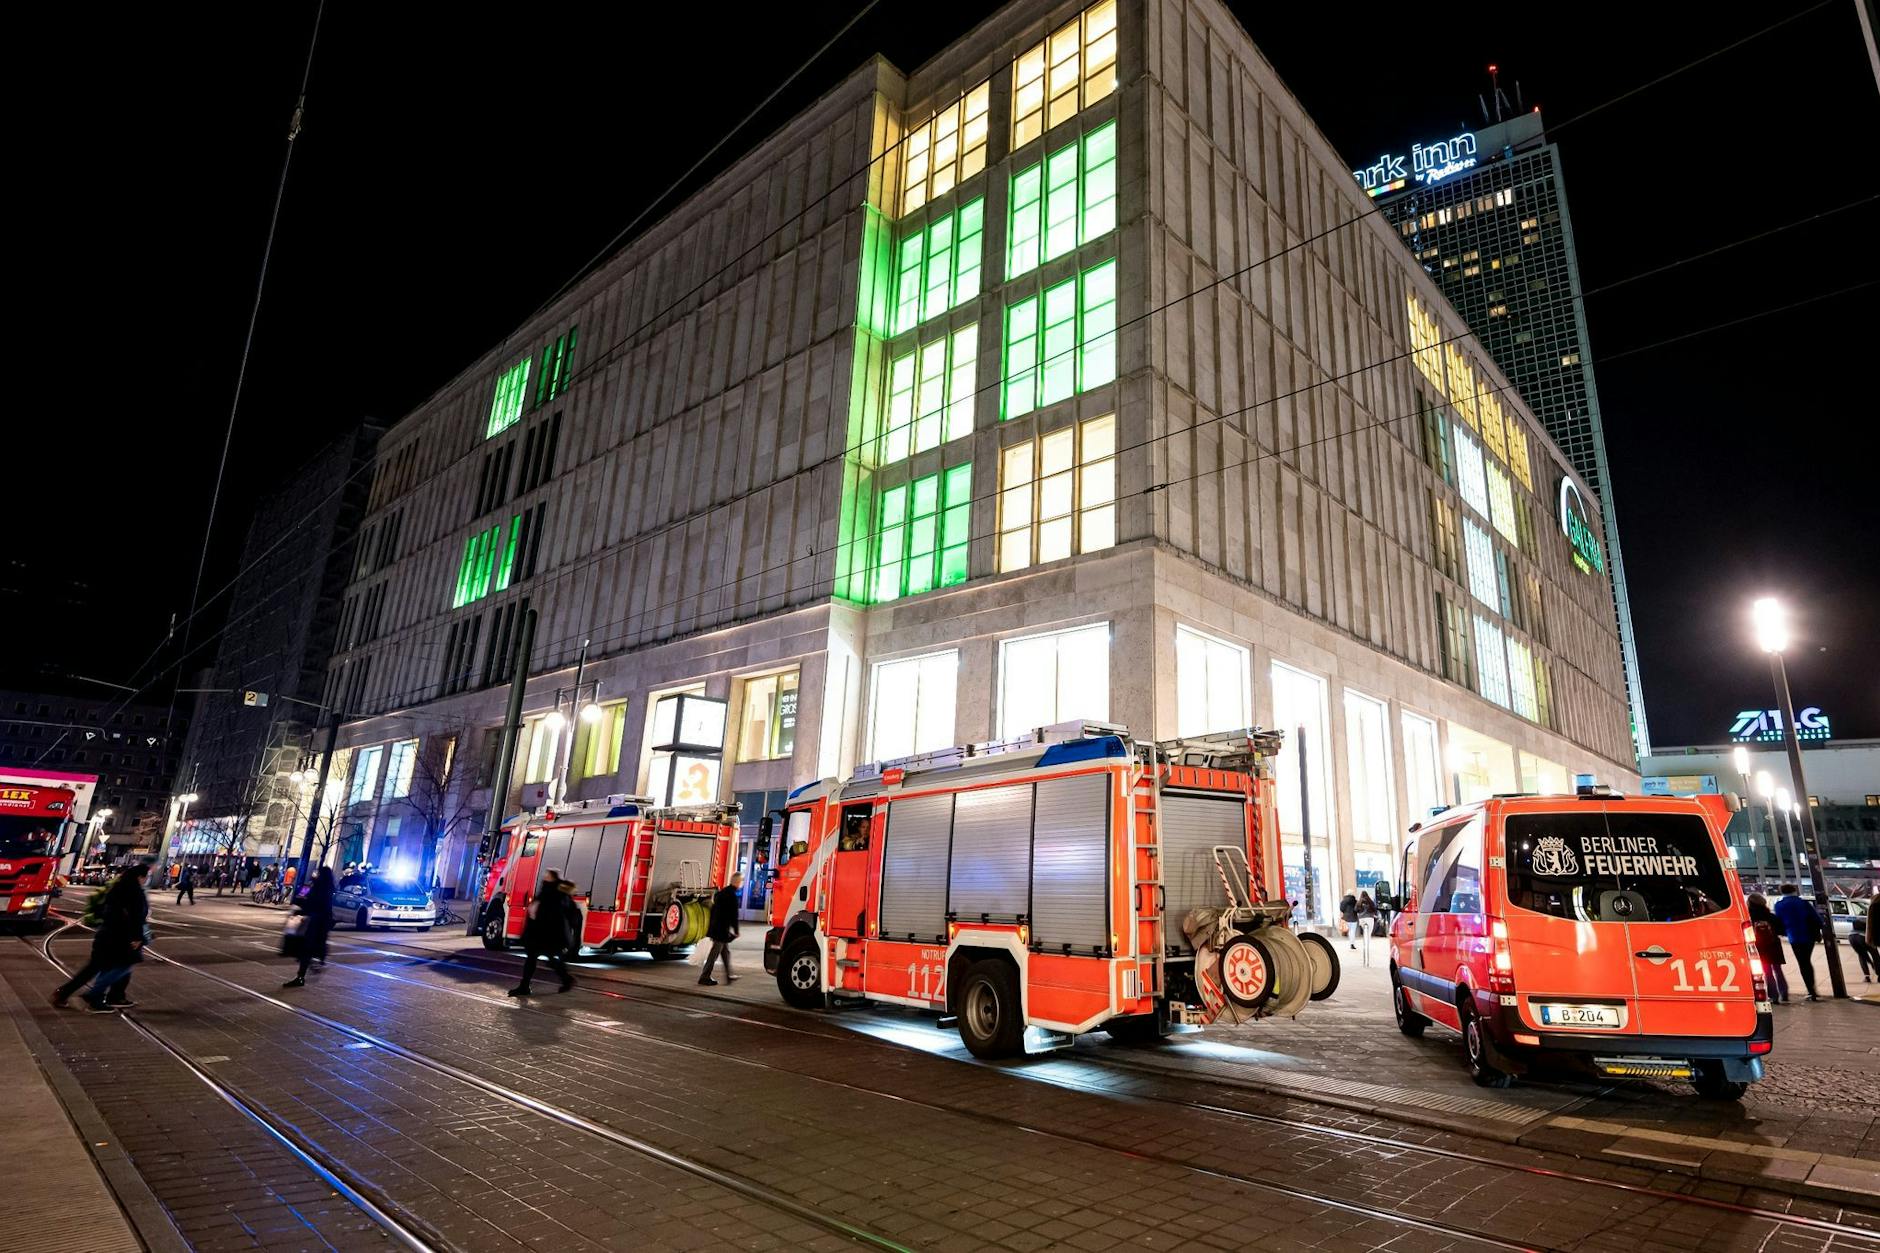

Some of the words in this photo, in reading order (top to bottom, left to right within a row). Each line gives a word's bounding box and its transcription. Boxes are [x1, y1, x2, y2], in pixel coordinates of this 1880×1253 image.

[1412, 132, 1476, 172] inn
[247, 693, 256, 702] 2
[1580, 836, 1659, 854] BERLINER
[1584, 855, 1699, 876] FEUERWEHR
[1699, 950, 1735, 960] NOTRUF
[907, 962, 945, 1002] 112
[1670, 958, 1740, 992] 112
[1562, 1009, 1570, 1021] B
[1577, 1009, 1604, 1023] 204
